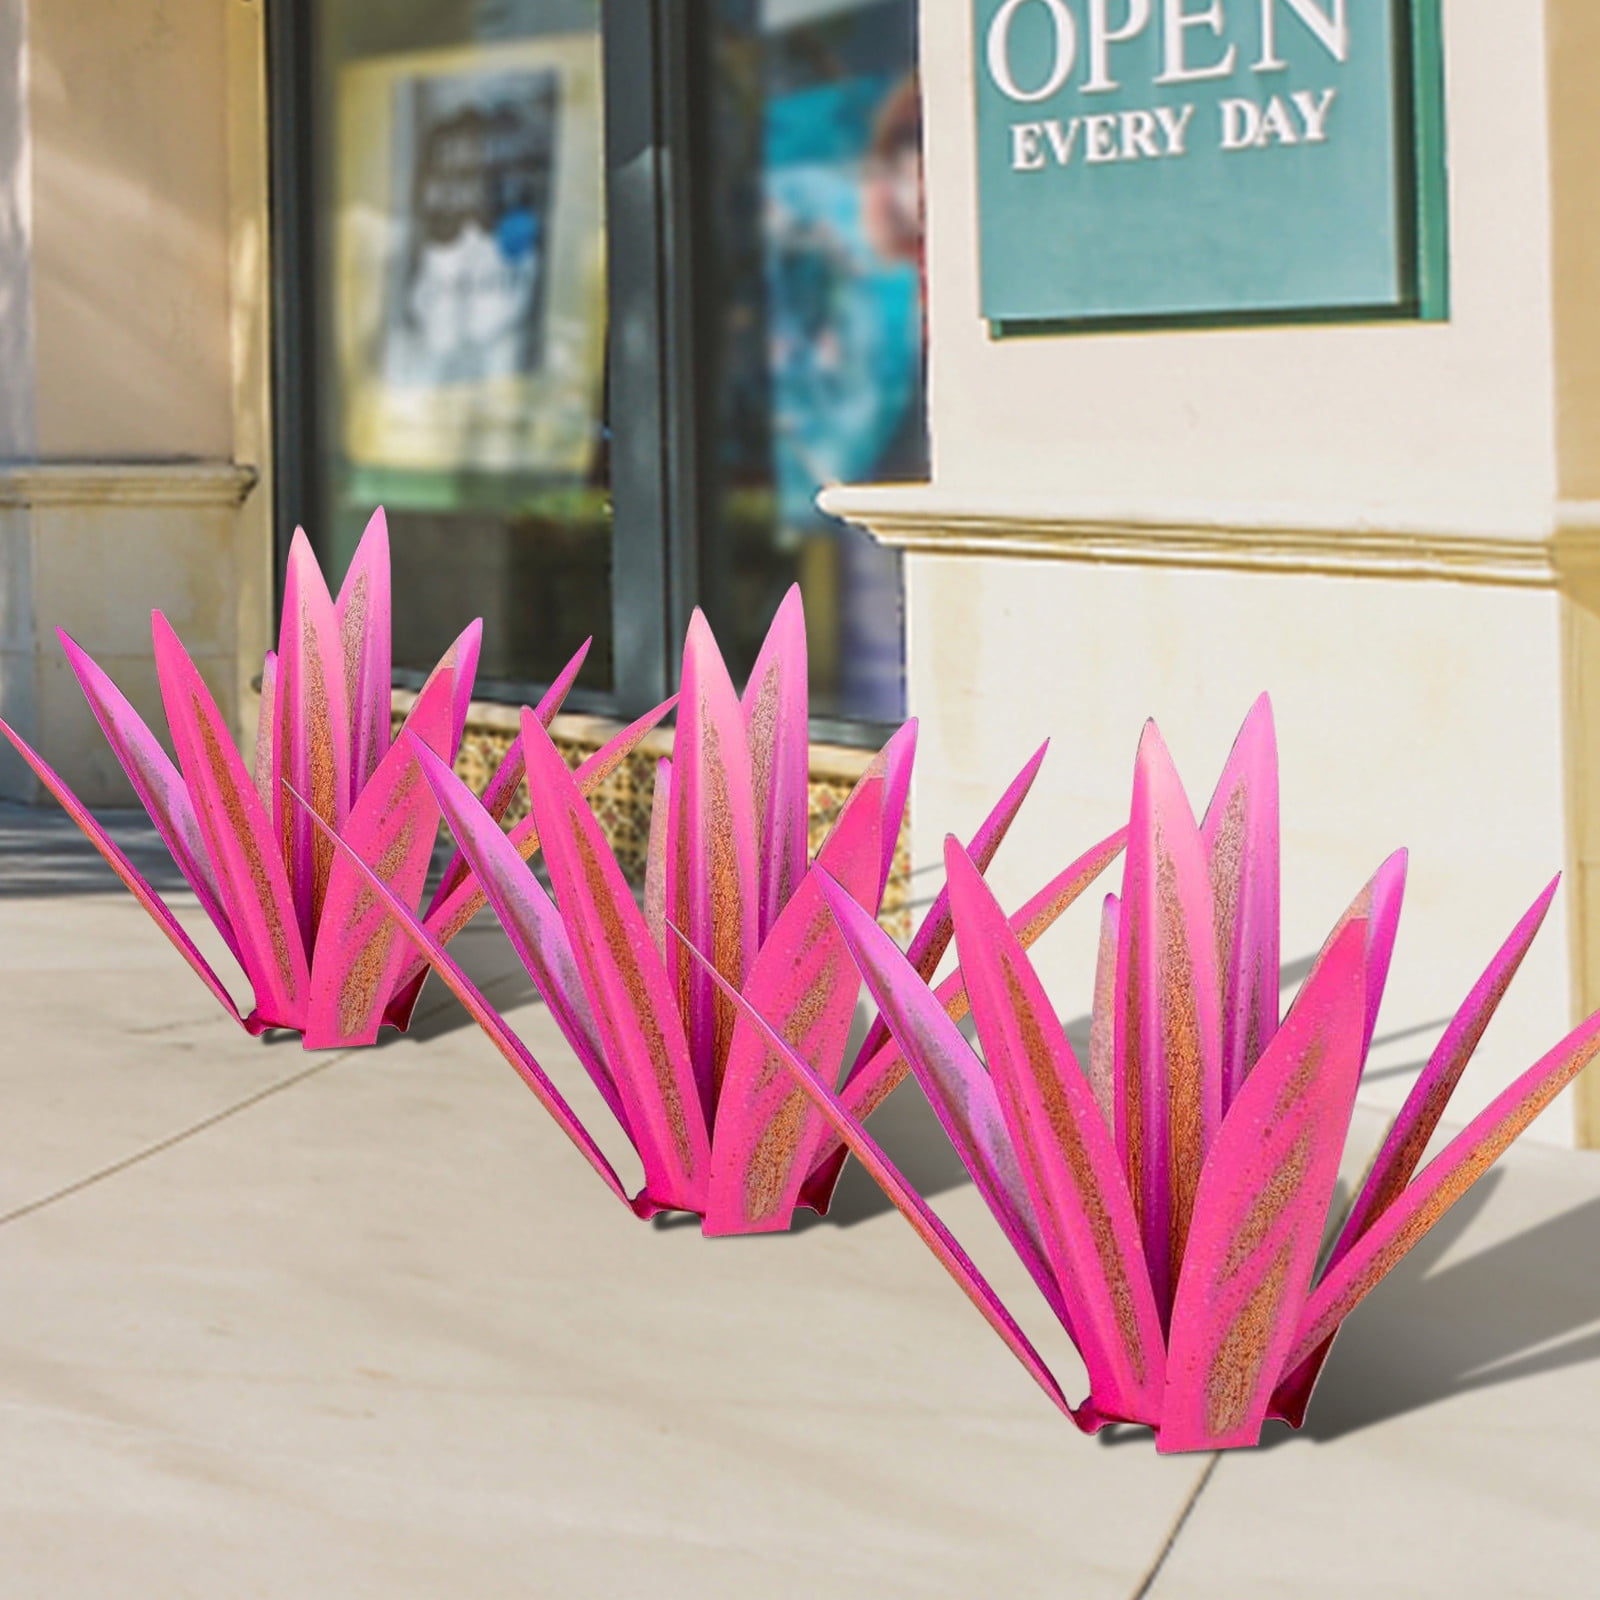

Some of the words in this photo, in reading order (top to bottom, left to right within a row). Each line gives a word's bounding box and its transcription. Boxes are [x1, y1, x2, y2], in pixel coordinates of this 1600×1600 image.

[987, 0, 1348, 102] OPEN
[1011, 104, 1194, 170] EVERY
[1220, 89, 1336, 149] DAY
